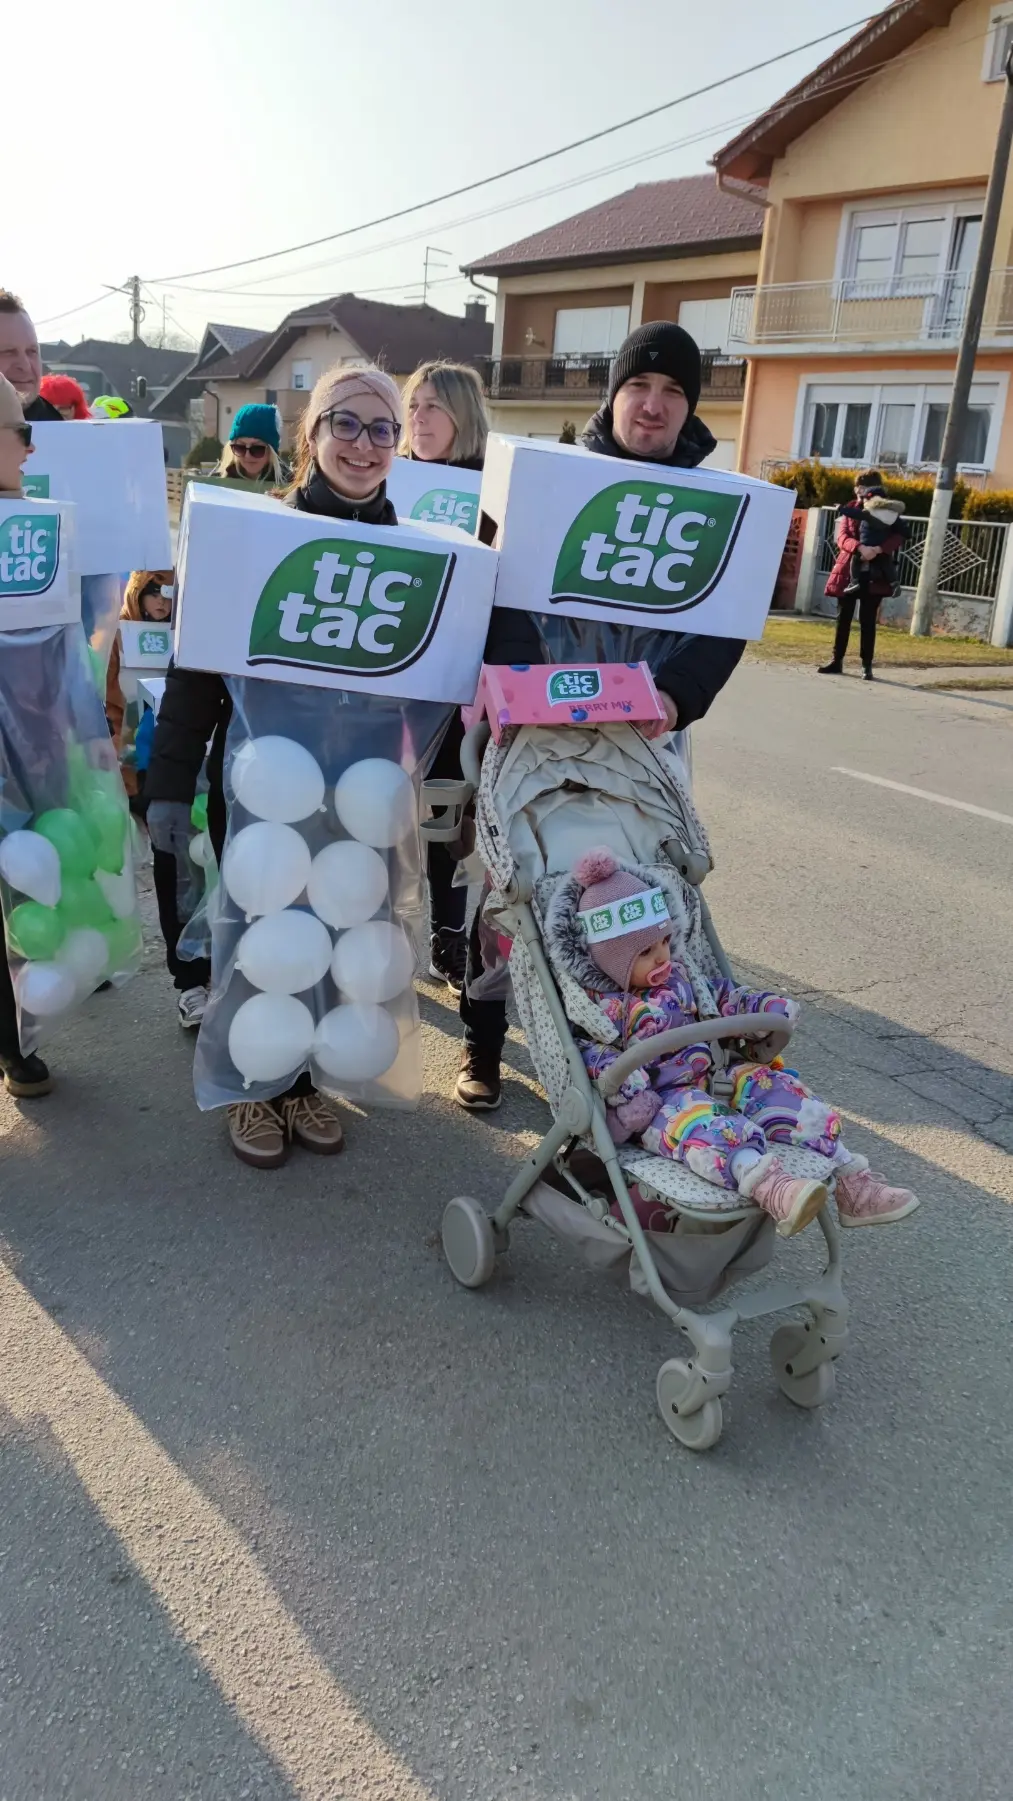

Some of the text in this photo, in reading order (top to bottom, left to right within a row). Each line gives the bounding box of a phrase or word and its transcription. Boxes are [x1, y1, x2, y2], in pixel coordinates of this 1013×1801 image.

[433, 494, 473, 518] tic
[615, 493, 708, 551] tic
[9, 520, 47, 555] tic
[0, 552, 46, 582] tac
[581, 532, 695, 592] tac
[313, 551, 413, 612] tic
[278, 592, 402, 654] tac
[557, 684, 593, 695] tac
[562, 673, 593, 685] tic
[568, 700, 635, 712] BERRY MIX
